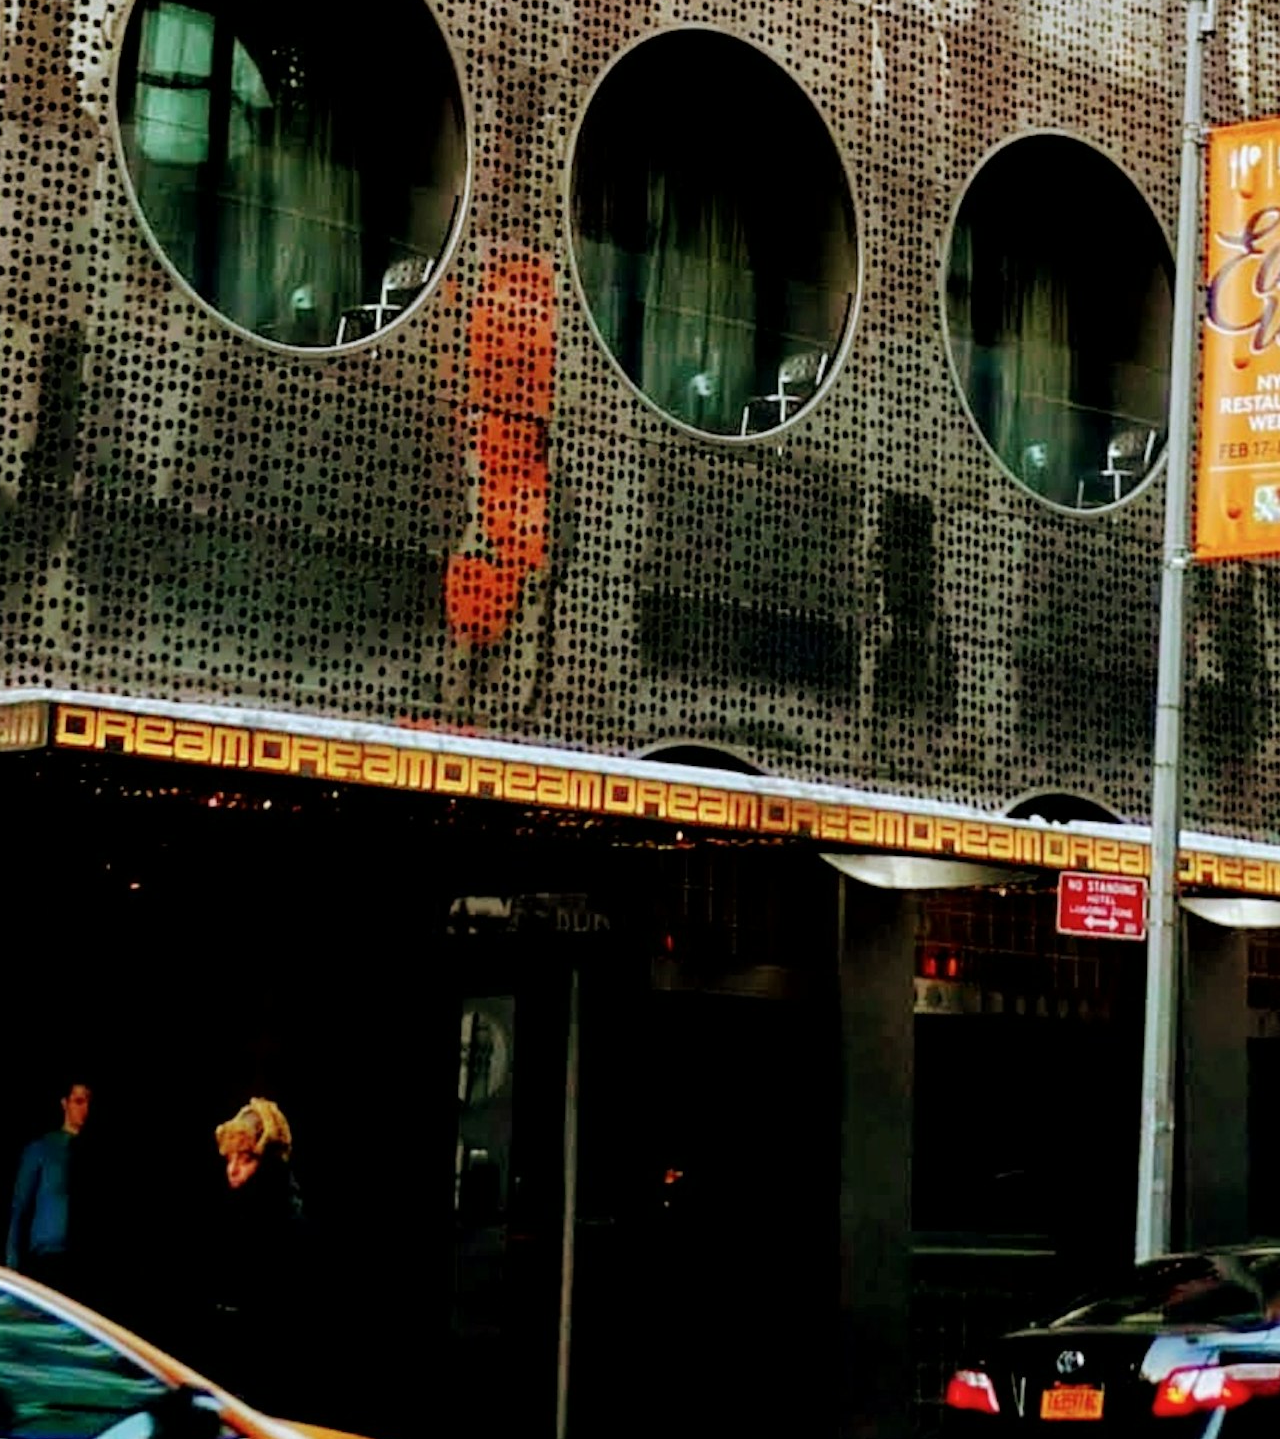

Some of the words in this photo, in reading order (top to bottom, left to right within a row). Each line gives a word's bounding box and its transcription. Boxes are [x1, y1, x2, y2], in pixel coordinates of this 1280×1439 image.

[1220, 442, 1249, 459] FEB
[1068, 879, 1083, 892] NO
[1087, 880, 1137, 897] STANDING
